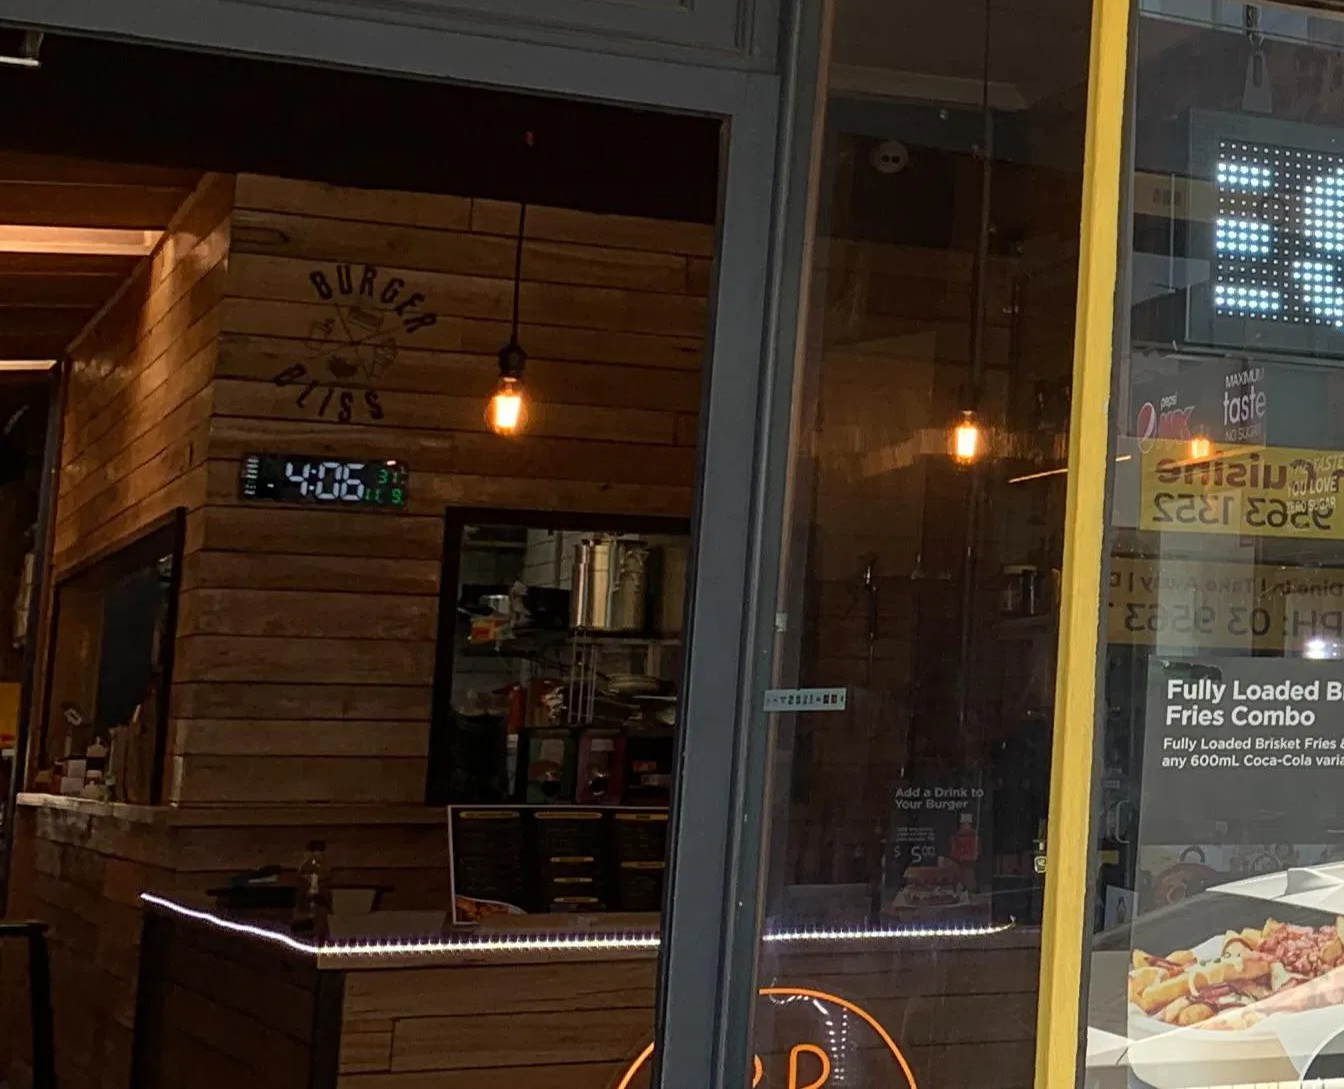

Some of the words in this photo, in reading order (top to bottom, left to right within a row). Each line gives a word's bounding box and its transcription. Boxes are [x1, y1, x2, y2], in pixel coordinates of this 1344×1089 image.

[310, 265, 437, 333] BURGER
[274, 364, 384, 422] BLISS
[1160, 391, 1178, 411] pepsi
[1223, 385, 1266, 426] taste
[286, 462, 364, 501] 4:06
[1309, 475, 1337, 494] LOVE
[1167, 678, 1226, 704] Fully
[1233, 679, 1319, 701] Loaded
[1166, 704, 1224, 726] Fries
[1231, 705, 1315, 726] Combo
[1163, 737, 1197, 752] Fully
[1200, 737, 1251, 750] Loaded
[1255, 737, 1301, 750] Brisket
[1304, 737, 1337, 750] Fries
[1162, 756, 1187, 769] any
[1191, 754, 1239, 767] 600mL
[1244, 754, 1312, 767] Coca-Cola
[895, 787, 919, 798] Add
[923, 789, 931, 798] a
[934, 787, 968, 798] Drink
[971, 788, 984, 798] to
[895, 799, 923, 810] Your
[926, 799, 968, 811] Burger
